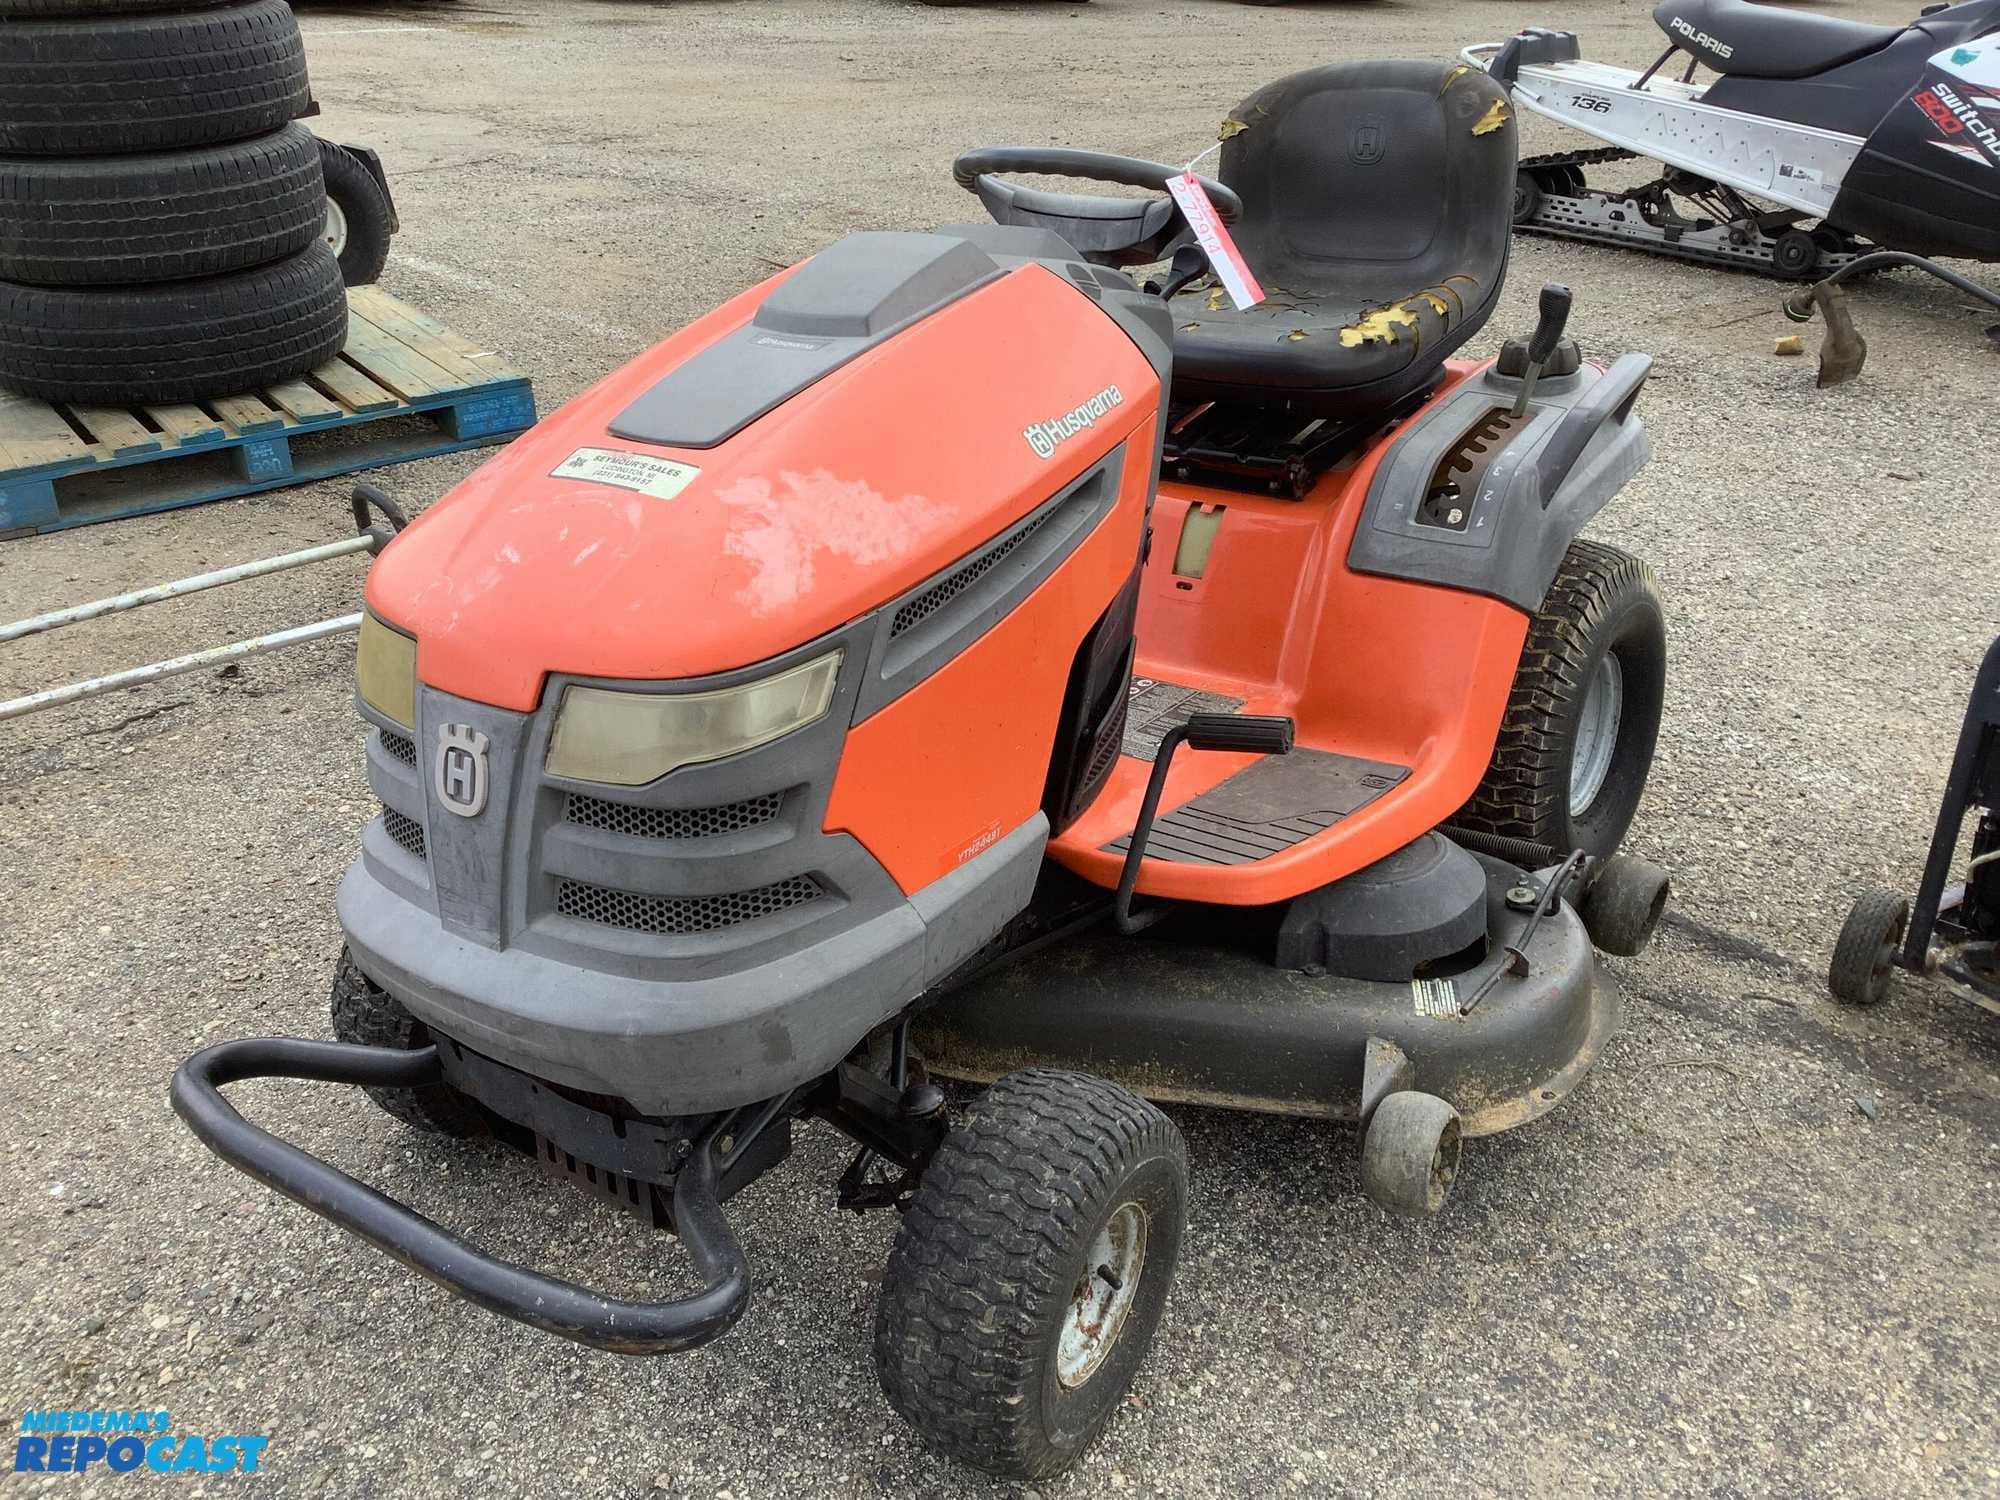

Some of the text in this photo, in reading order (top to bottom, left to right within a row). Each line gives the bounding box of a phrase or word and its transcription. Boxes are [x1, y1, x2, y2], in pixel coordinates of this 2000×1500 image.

[1670, 16, 1734, 59] POLARIS
[1572, 96, 1612, 113] 136
[1913, 91, 1966, 134] 800
[1042, 384, 1124, 445] Husqvarna
[593, 454, 682, 478] SEYMOUR'S SALES
